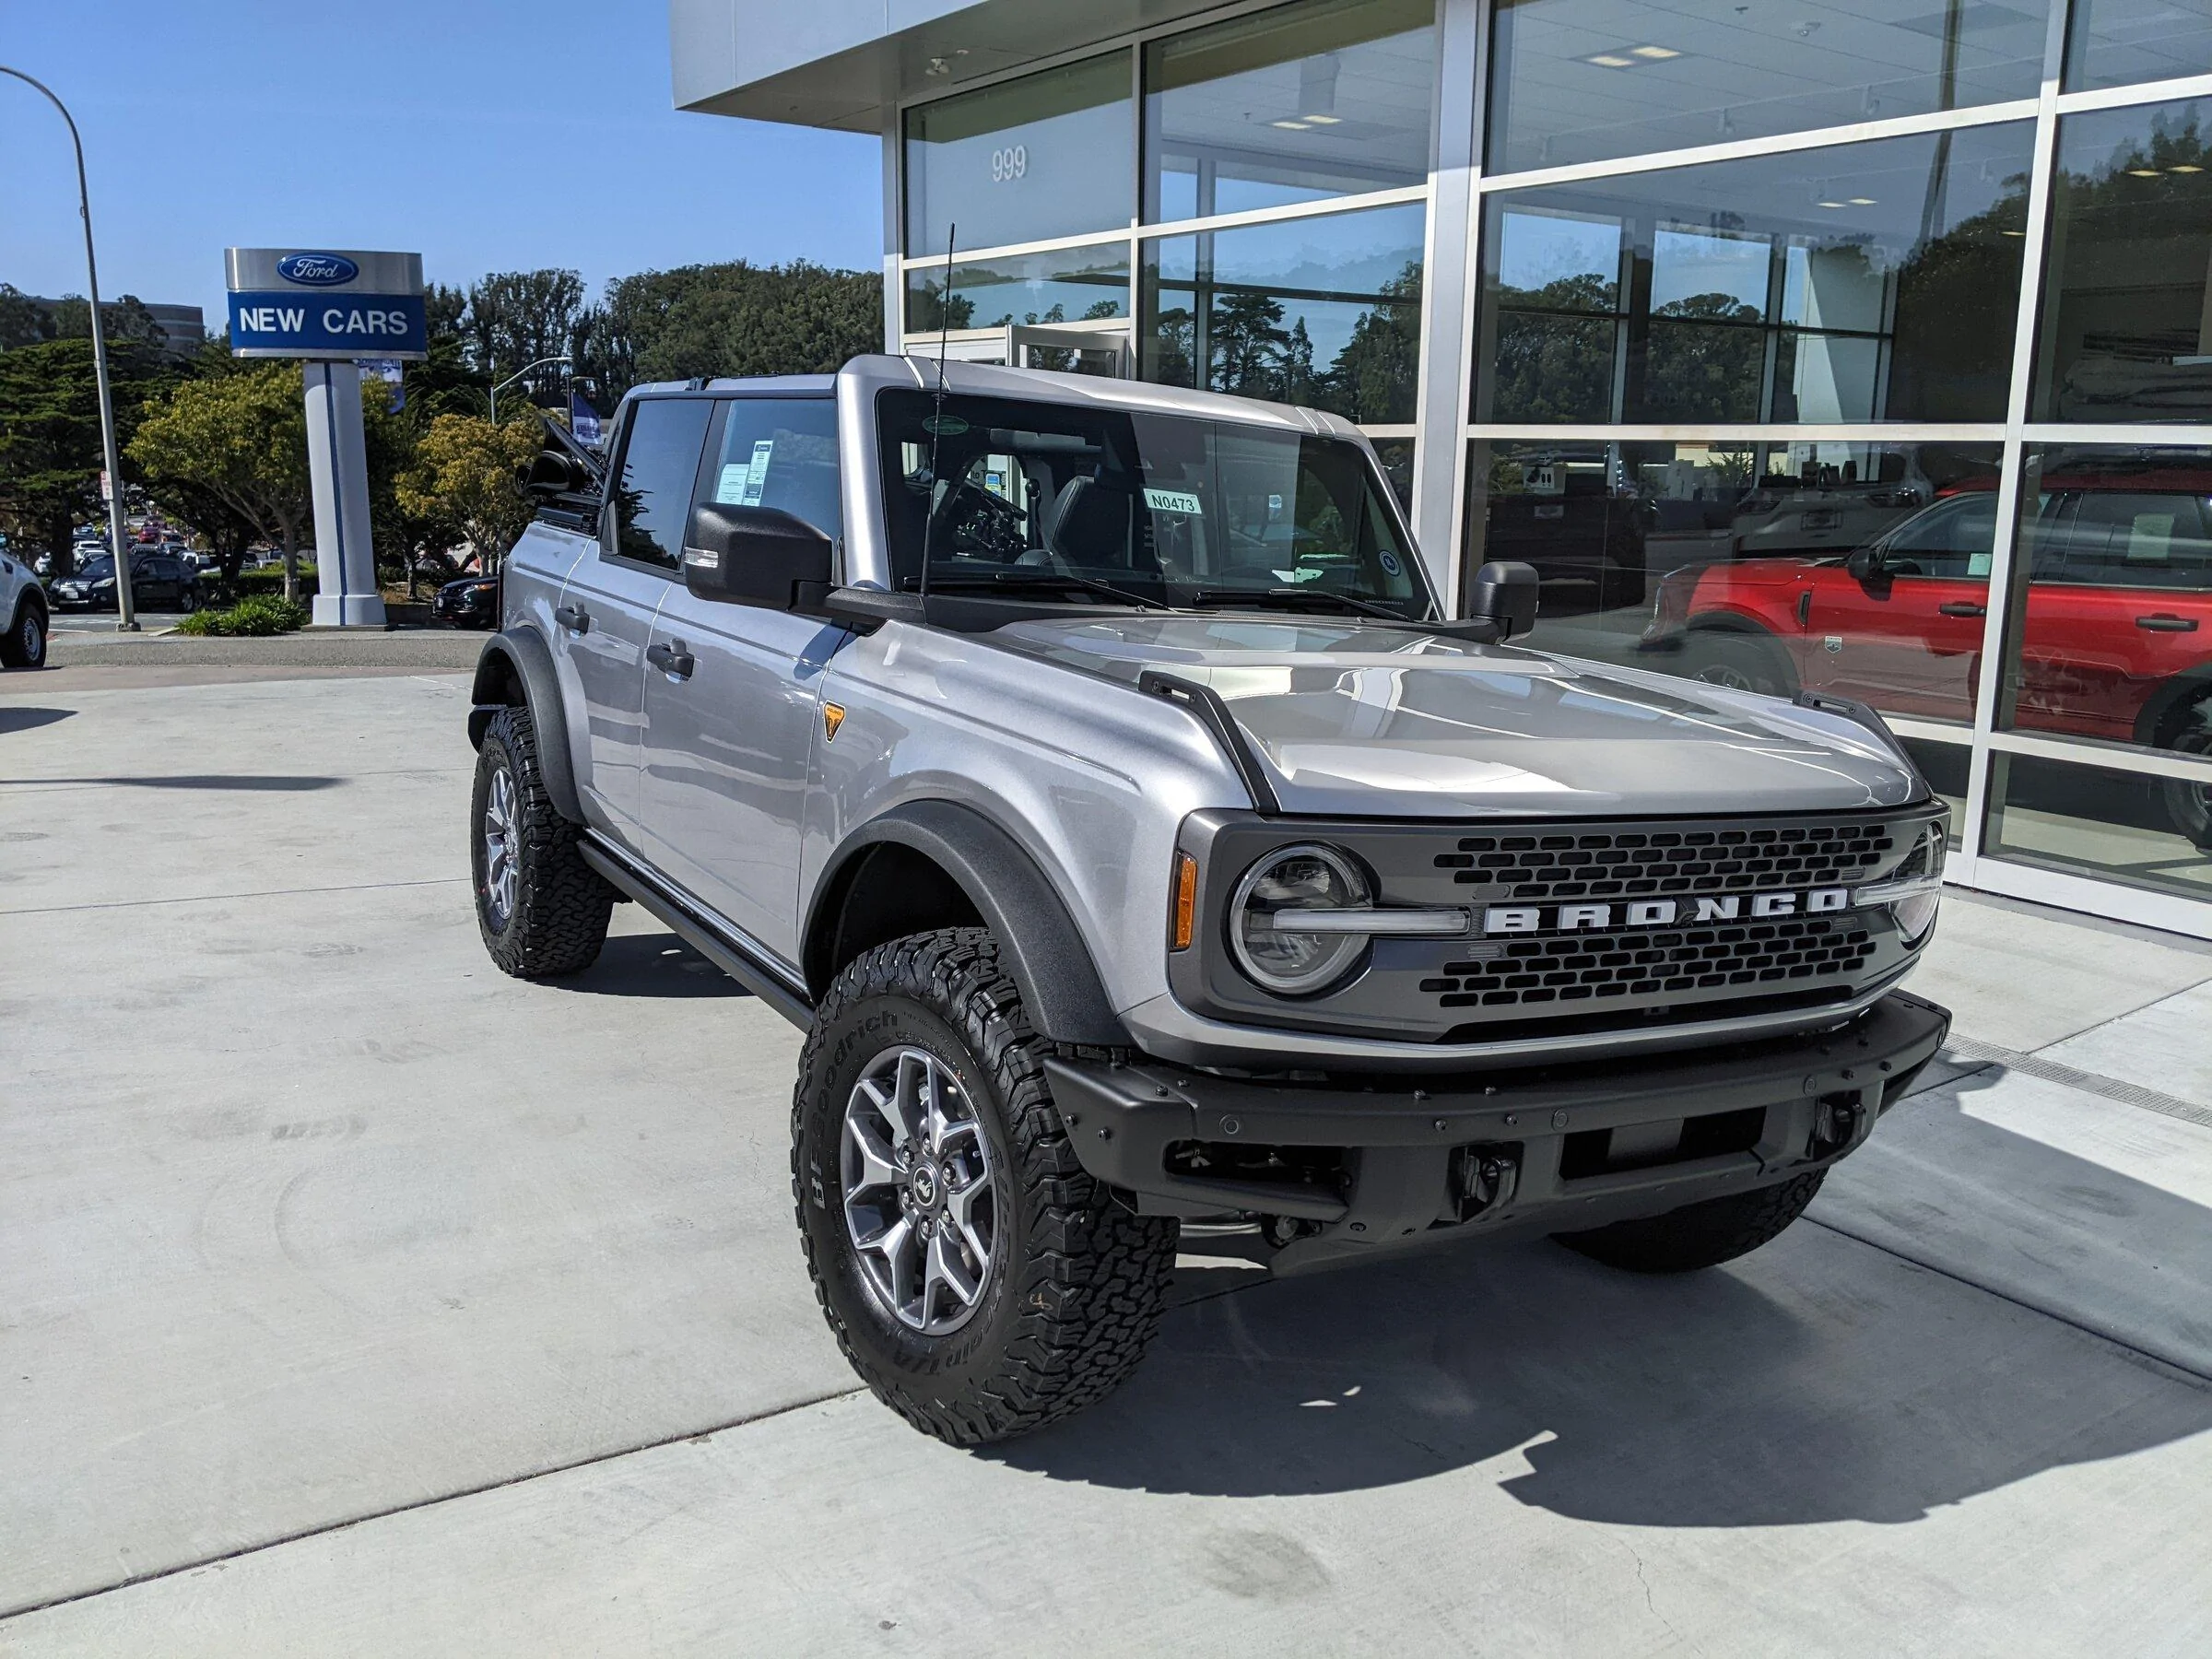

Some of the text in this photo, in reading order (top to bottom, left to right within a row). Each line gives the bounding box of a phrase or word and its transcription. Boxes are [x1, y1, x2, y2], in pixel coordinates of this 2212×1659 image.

[993, 145, 1025, 182] 999
[292, 258, 338, 278] Ford
[240, 307, 408, 335] NEW CARS
[1151, 494, 1195, 512] N0473
[1483, 888, 1848, 934] BRONCO
